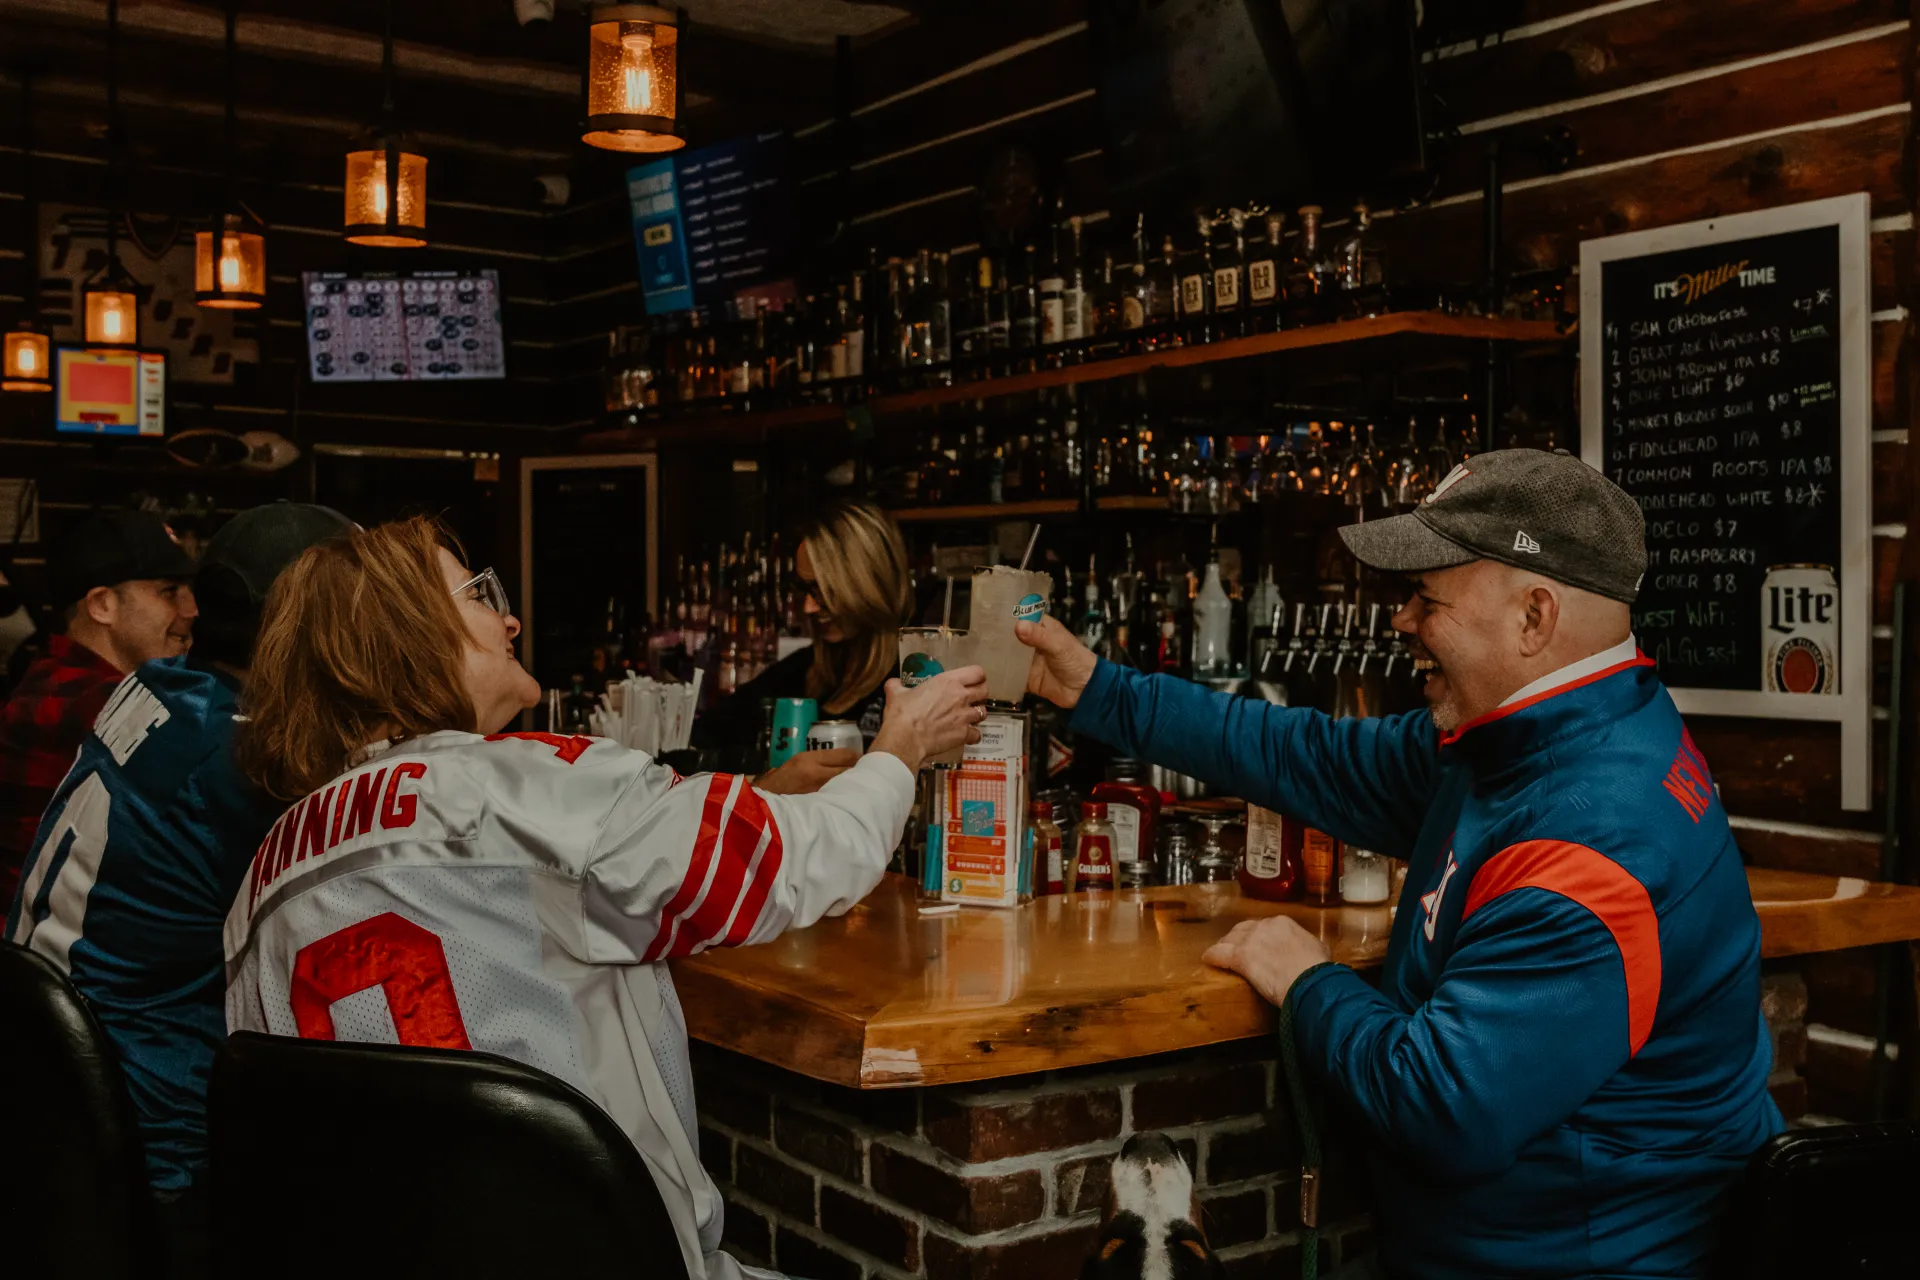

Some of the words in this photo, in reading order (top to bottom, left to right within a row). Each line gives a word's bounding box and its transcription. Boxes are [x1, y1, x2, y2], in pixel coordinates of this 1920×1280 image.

[1678, 258, 1751, 305] Miller
[1738, 265, 1777, 288] TIME
[1628, 344, 1675, 366] GREAT
[1612, 371, 1621, 388] 3
[1629, 364, 1672, 384] JOHN
[1676, 358, 1727, 379] BROWN
[1734, 356, 1755, 369] IPA
[1671, 377, 1714, 398] LIGHT
[1628, 435, 1718, 460] FIDDLEHEAD
[1733, 430, 1760, 449] IPA
[1780, 419, 1802, 440] $8
[1627, 465, 1692, 485] COMMON
[1712, 459, 1768, 478] ROOTS
[1780, 457, 1807, 476] IPA
[1726, 489, 1774, 508] WHITE
[1645, 520, 1701, 539] ODELO
[1714, 518, 1739, 540] $7
[1669, 547, 1757, 566] RASPBERRY
[1655, 573, 1699, 591] CIDER
[1712, 573, 1738, 594] $8
[1768, 586, 1833, 634] Lite
[1077, 864, 1111, 876] GULDEN'S
